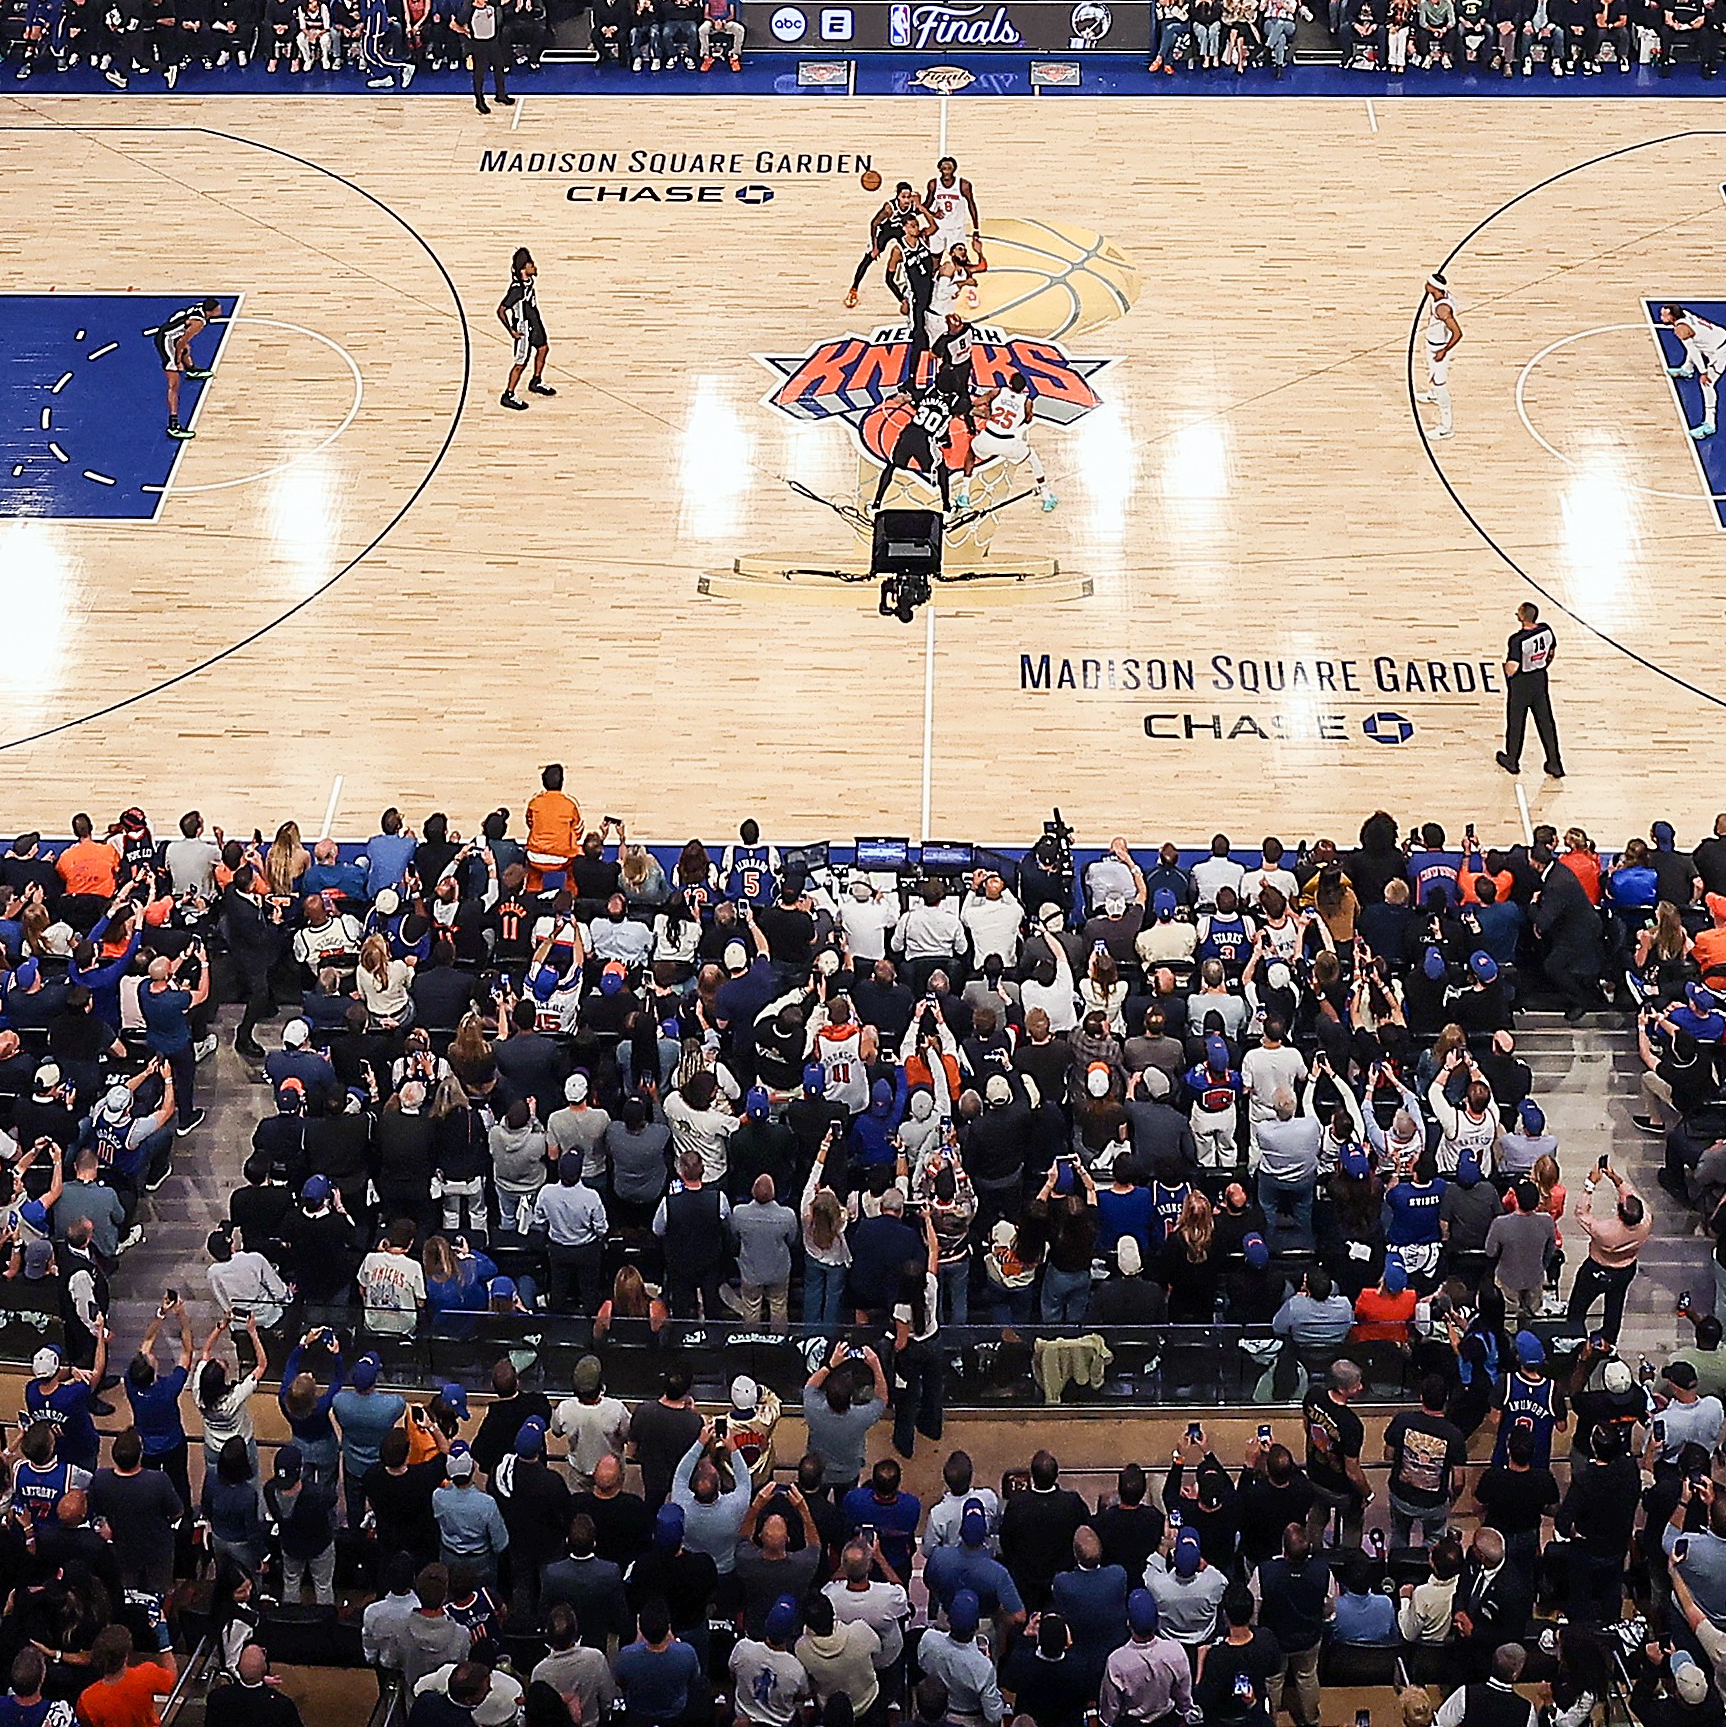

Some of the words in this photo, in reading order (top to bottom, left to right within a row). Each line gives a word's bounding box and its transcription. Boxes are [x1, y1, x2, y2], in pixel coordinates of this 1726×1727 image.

[775, 17, 802, 29] abc
[913, 5, 1019, 48] Finals
[479, 149, 617, 173] MADISON
[628, 150, 745, 176] SQUARE
[755, 150, 873, 174] GARDEN
[567, 185, 726, 203] CHASE
[944, 201, 953, 212] 8
[913, 406, 942, 431] 30
[991, 407, 1016, 429] 25
[1020, 654, 1195, 691] MADISON
[1212, 656, 1358, 695] SQUARE
[1374, 656, 1507, 694] GARDE
[743, 871, 760, 897] 5
[502, 916, 518, 940] 11
[1213, 932, 1243, 945] STARKS
[1220, 946, 1236, 960] 3
[832, 1064, 850, 1084] 11
[31, 1501, 52, 1518] 7
